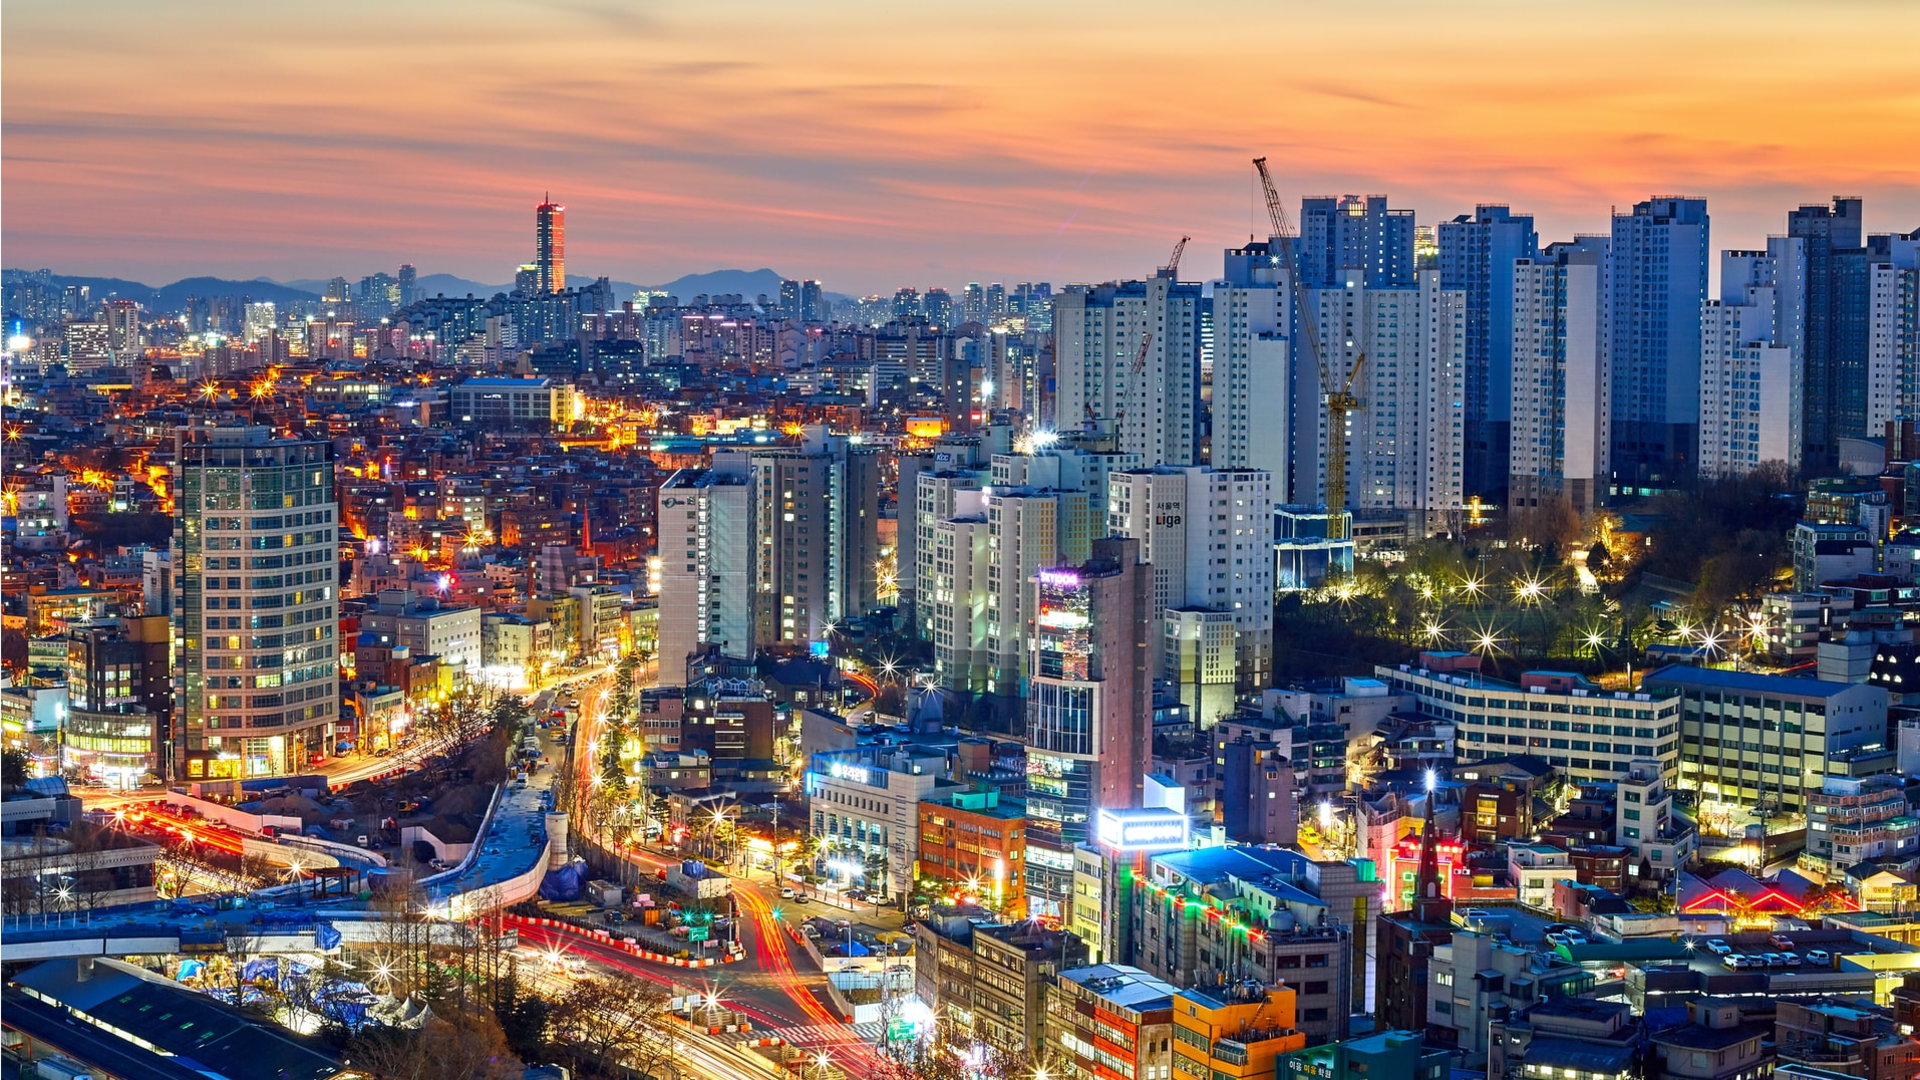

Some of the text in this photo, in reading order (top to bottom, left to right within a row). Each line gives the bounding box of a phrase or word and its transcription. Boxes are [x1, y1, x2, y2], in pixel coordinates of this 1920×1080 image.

[1157, 502, 1180, 510] 서울역
[1156, 513, 1181, 528] Liga
[1289, 1060, 1332, 1079] 이용 미용 학원
